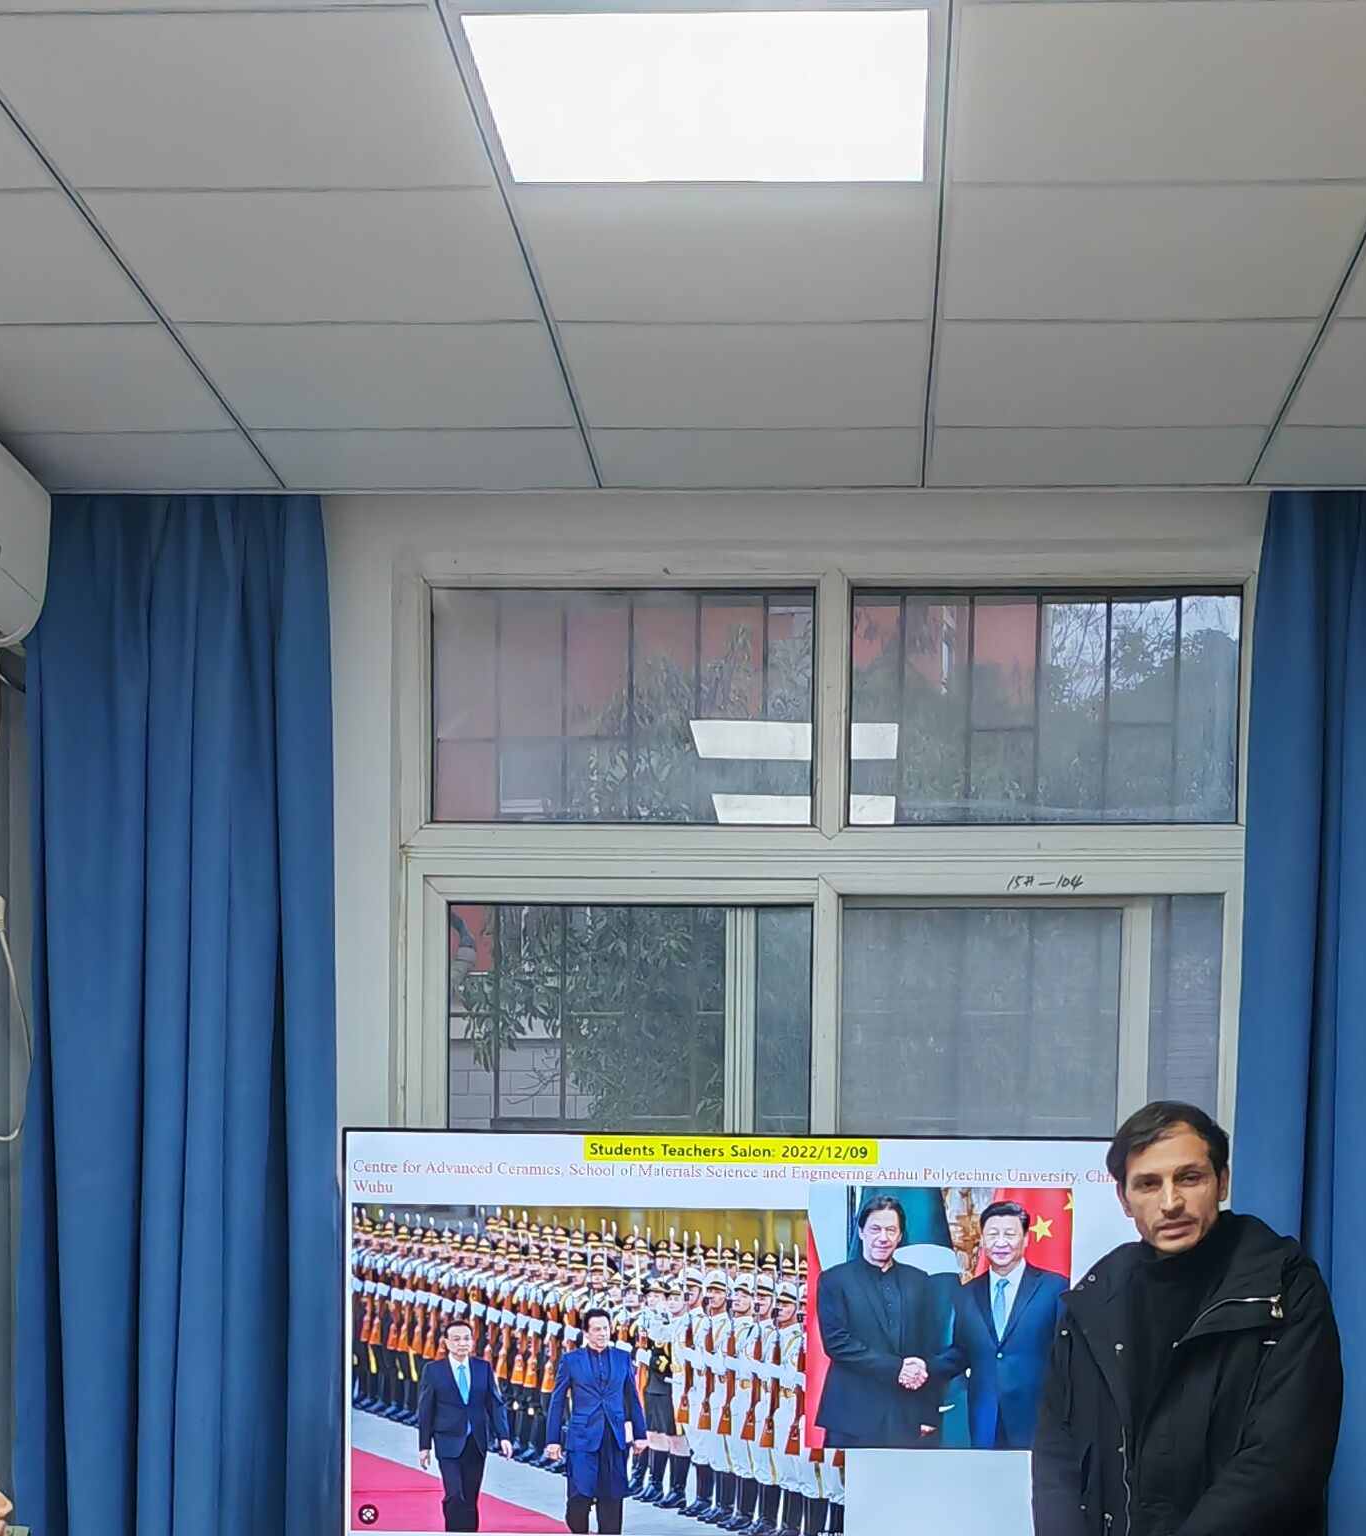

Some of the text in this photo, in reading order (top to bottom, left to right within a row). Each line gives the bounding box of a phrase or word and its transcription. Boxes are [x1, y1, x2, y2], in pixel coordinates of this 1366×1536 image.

[590, 1142, 868, 1160] Students Teachers Salon: 2022/12/09
[353, 1159, 398, 1174] Centre
[402, 1160, 422, 1174] for
[425, 1160, 493, 1176] Advanced
[569, 1162, 616, 1178] School
[620, 1163, 636, 1178] of
[638, 1163, 702, 1179] Materials
[706, 1165, 758, 1179] Science
[762, 1166, 786, 1180] and
[791, 1166, 873, 1183] Engineering
[877, 1167, 919, 1181] Anhui
[923, 1167, 1002, 1184] Polytechnic
[353, 1179, 394, 1194] Wuhu
